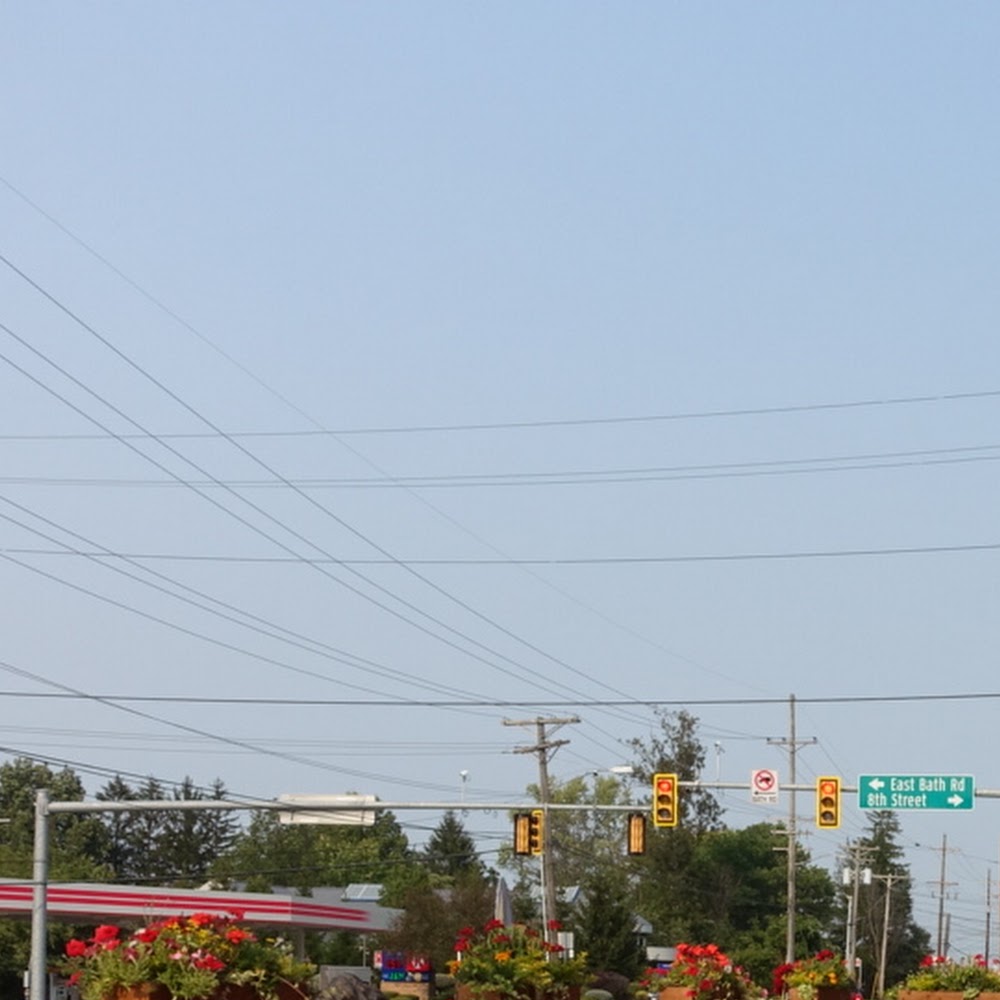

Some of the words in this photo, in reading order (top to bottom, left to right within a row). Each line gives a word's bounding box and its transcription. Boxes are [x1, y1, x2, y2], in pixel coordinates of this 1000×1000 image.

[890, 778, 915, 791] East
[919, 778, 945, 791] Bath
[950, 778, 965, 792] Rd
[867, 793, 887, 806] 8th
[891, 793, 927, 806] Street
